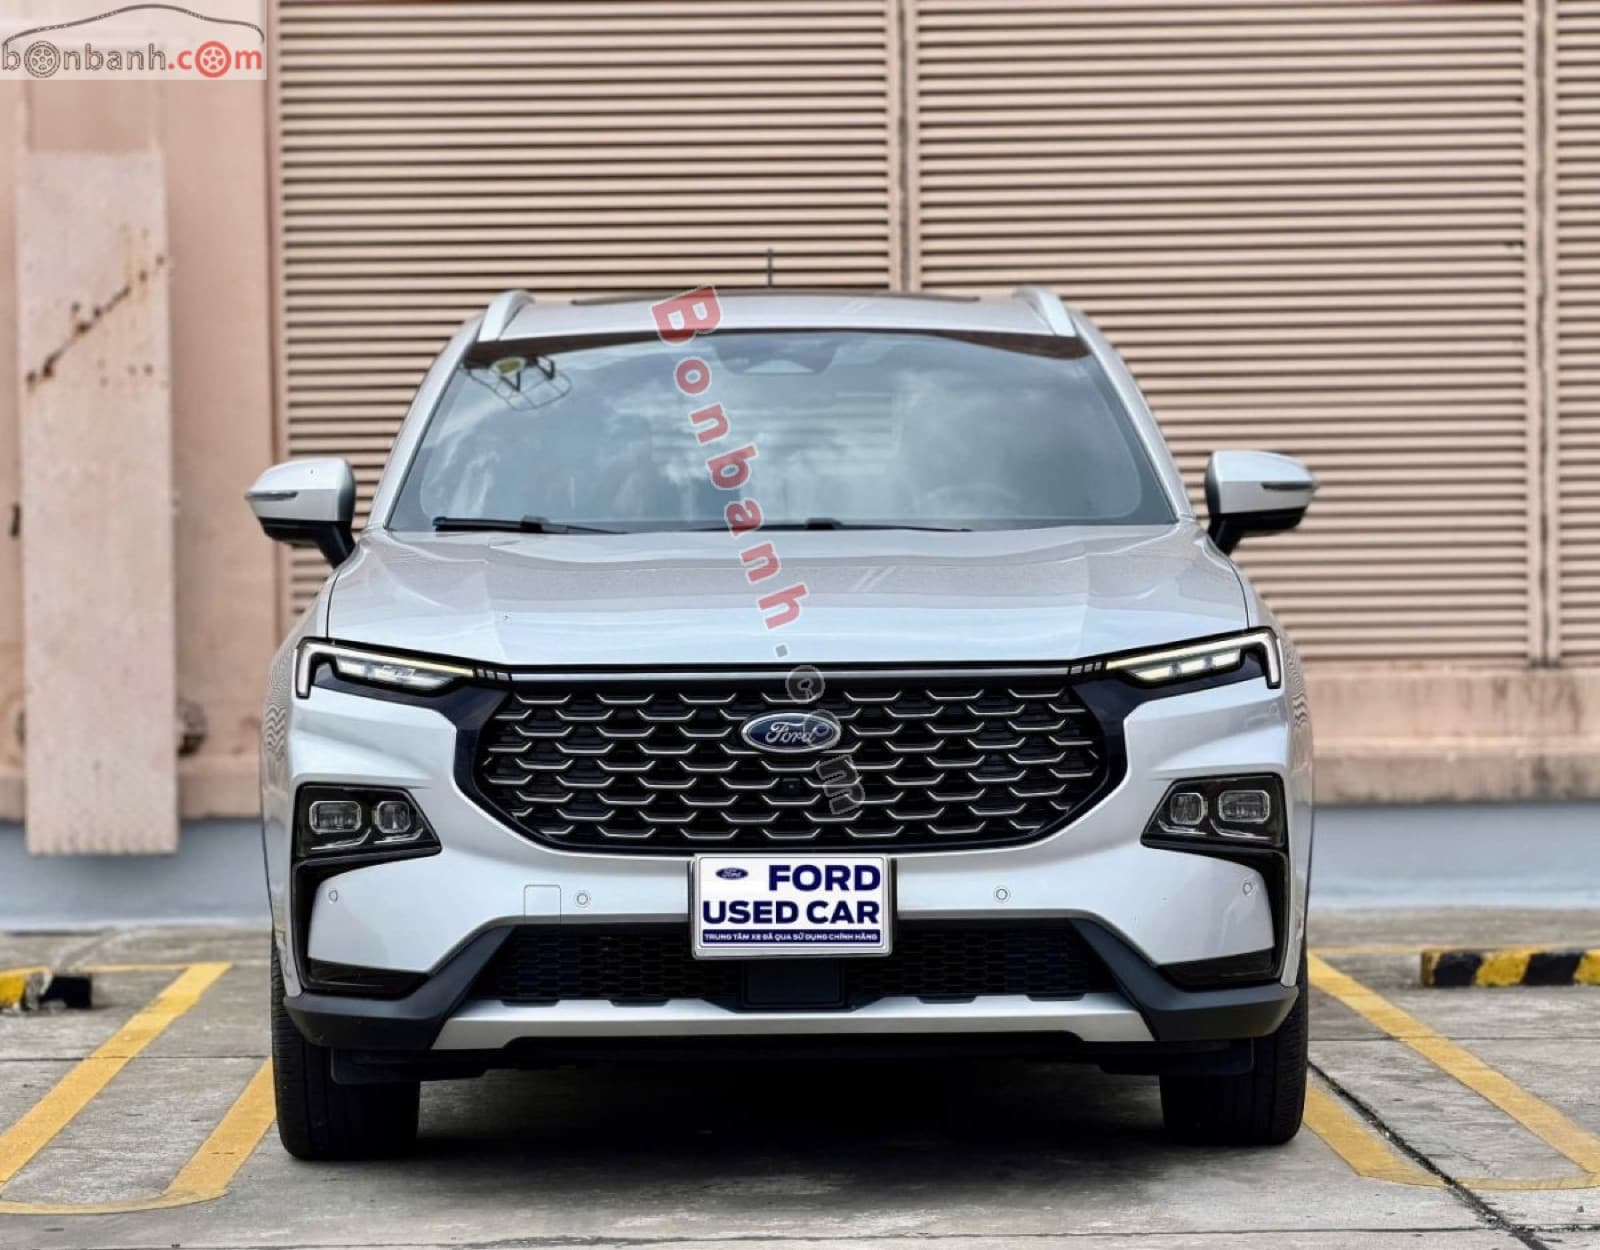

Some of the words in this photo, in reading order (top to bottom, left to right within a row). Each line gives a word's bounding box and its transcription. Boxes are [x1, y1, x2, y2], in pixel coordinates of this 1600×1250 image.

[764, 721, 818, 744] Ford
[768, 864, 881, 892] FORD
[703, 900, 799, 925] USED
[806, 900, 880, 925] CAR
[704, 933, 731, 941] TRUNG
[751, 933, 761, 941] XE
[774, 933, 792, 942] QUA
